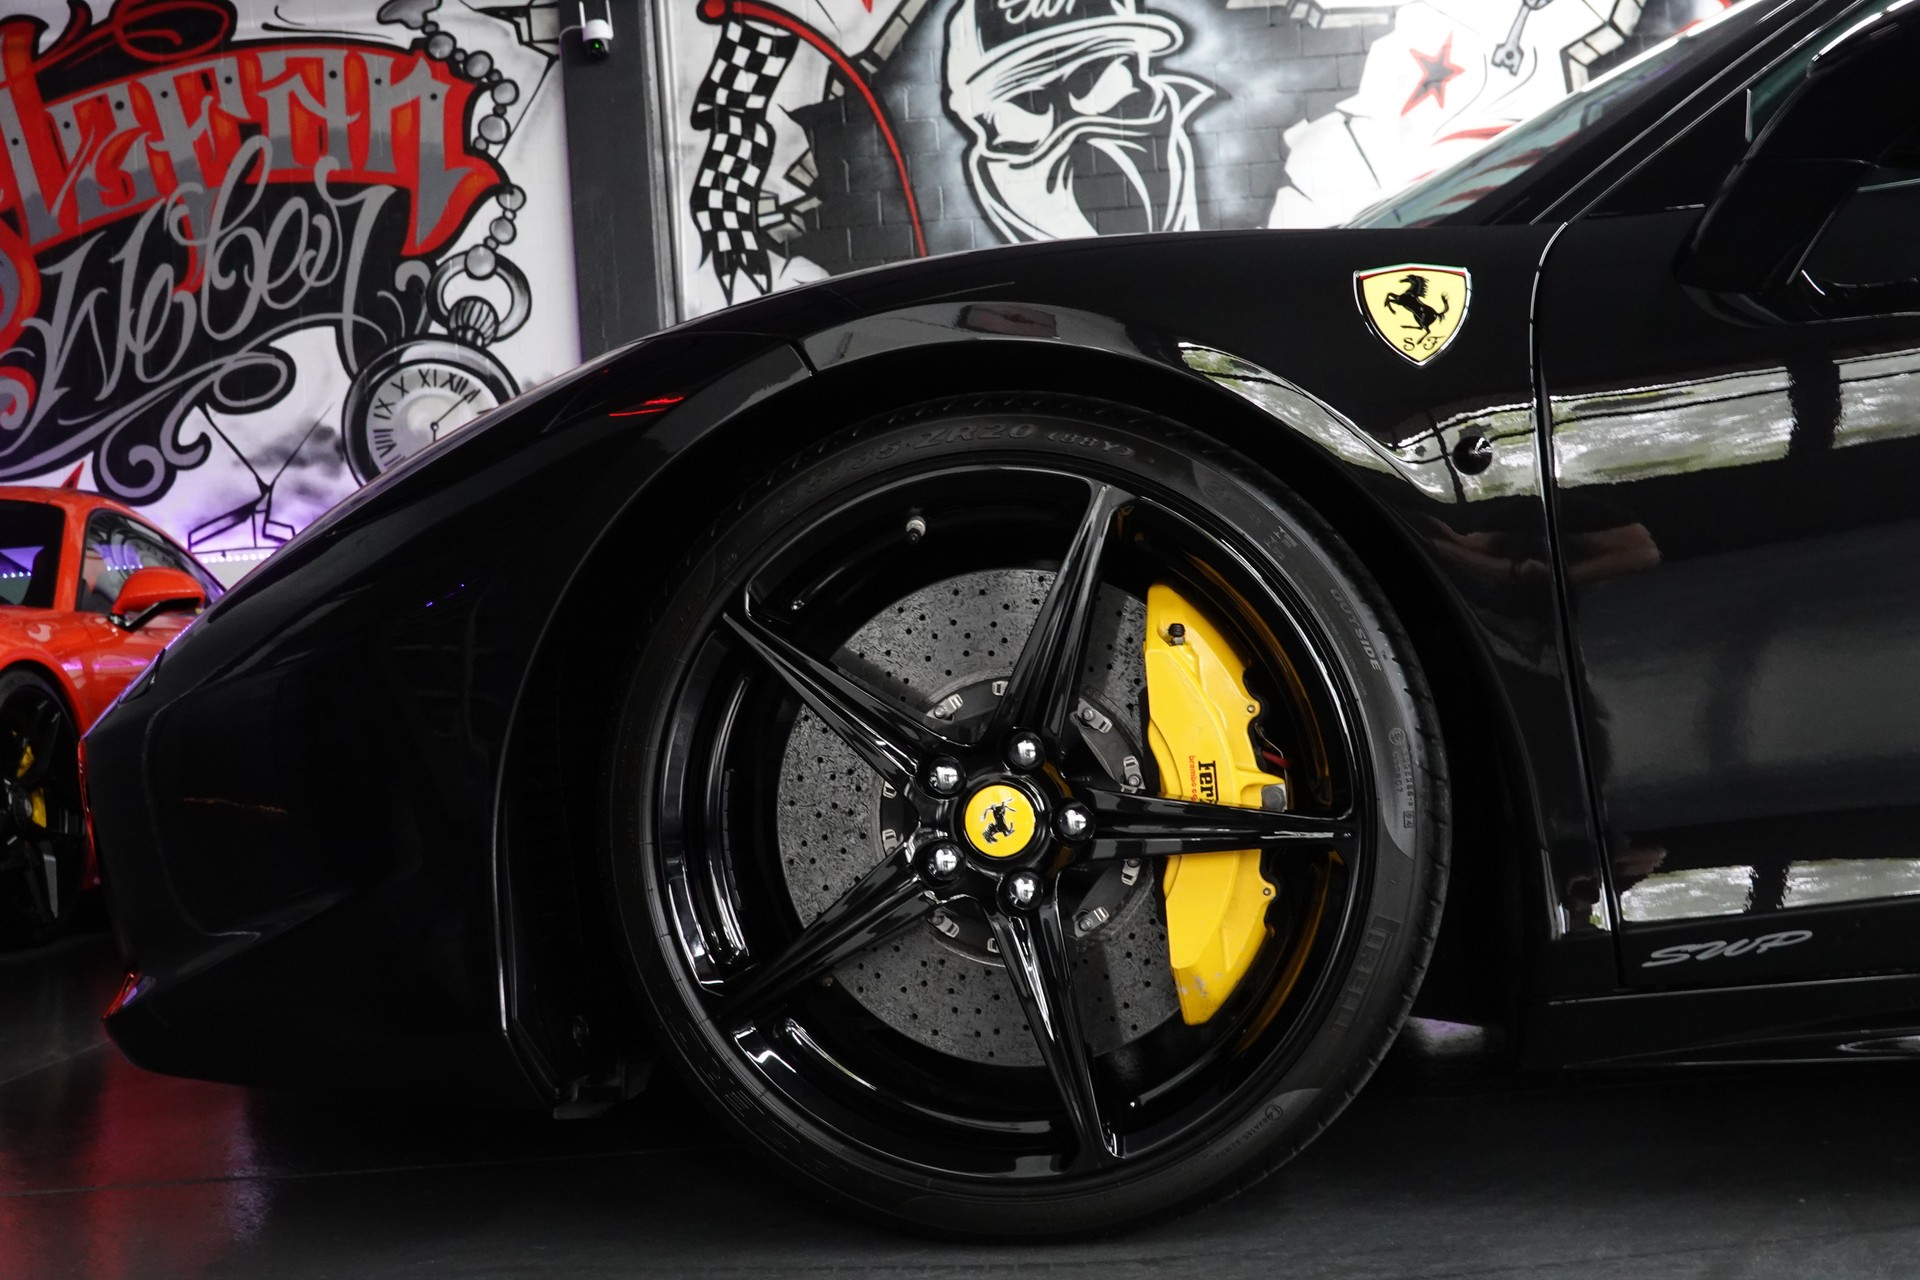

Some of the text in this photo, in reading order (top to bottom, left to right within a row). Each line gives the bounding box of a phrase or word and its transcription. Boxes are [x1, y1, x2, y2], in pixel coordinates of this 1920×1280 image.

[912, 423, 1038, 451] ZR20
[1329, 588, 1382, 671] OUTSIDE
[1641, 929, 1814, 969] SWP
